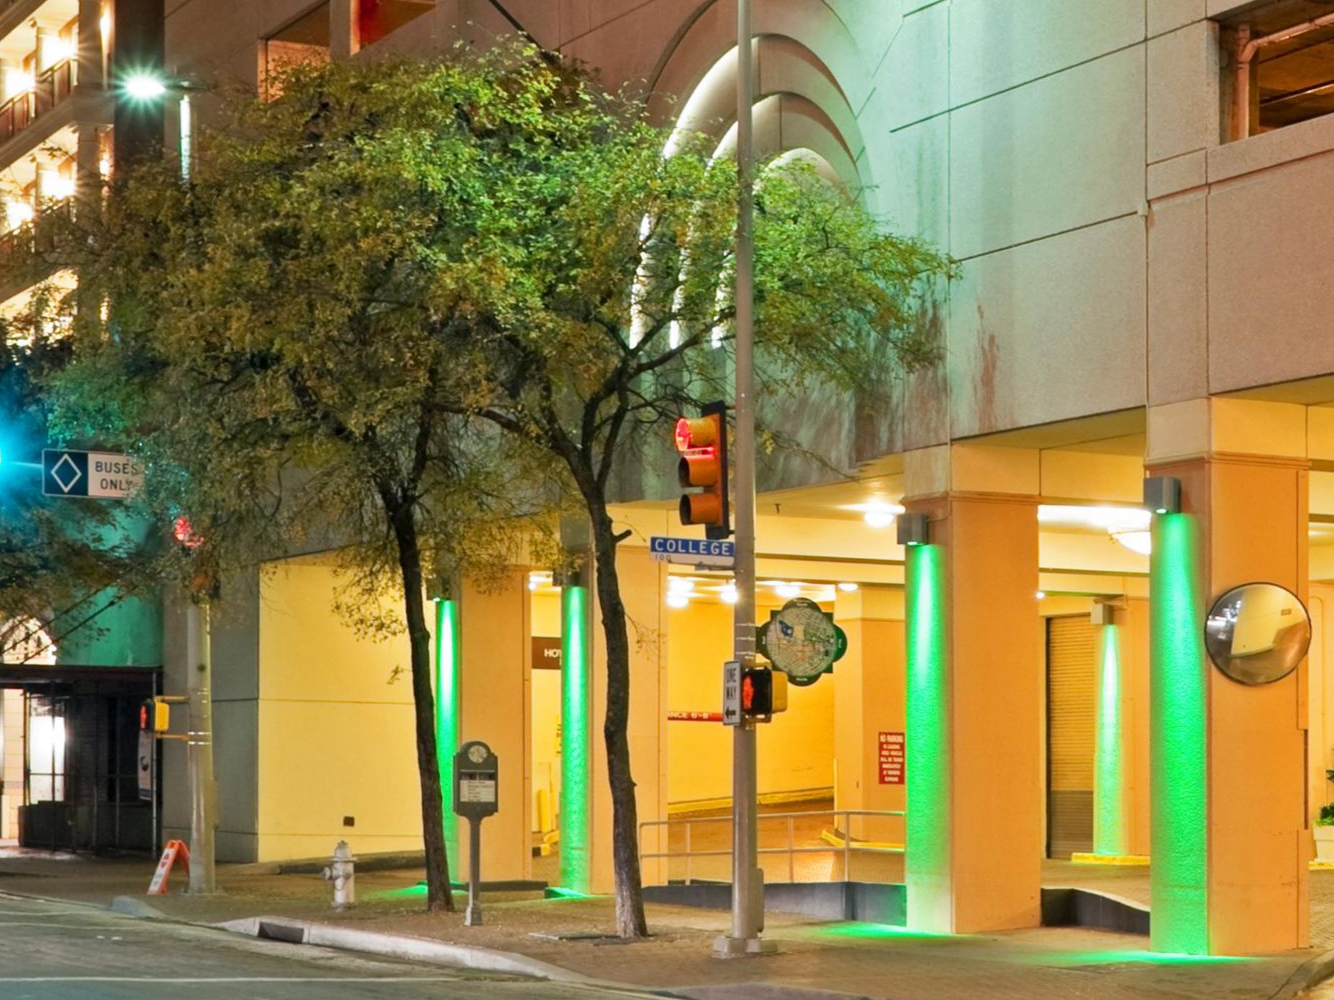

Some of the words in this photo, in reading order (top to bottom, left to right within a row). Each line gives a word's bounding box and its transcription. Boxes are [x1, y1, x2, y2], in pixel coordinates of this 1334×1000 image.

[95, 461, 138, 475] BUSES
[100, 478, 134, 491] ONLY
[655, 539, 731, 555] COLLEGE
[727, 668, 737, 683] ONE
[726, 685, 737, 699] WAY
